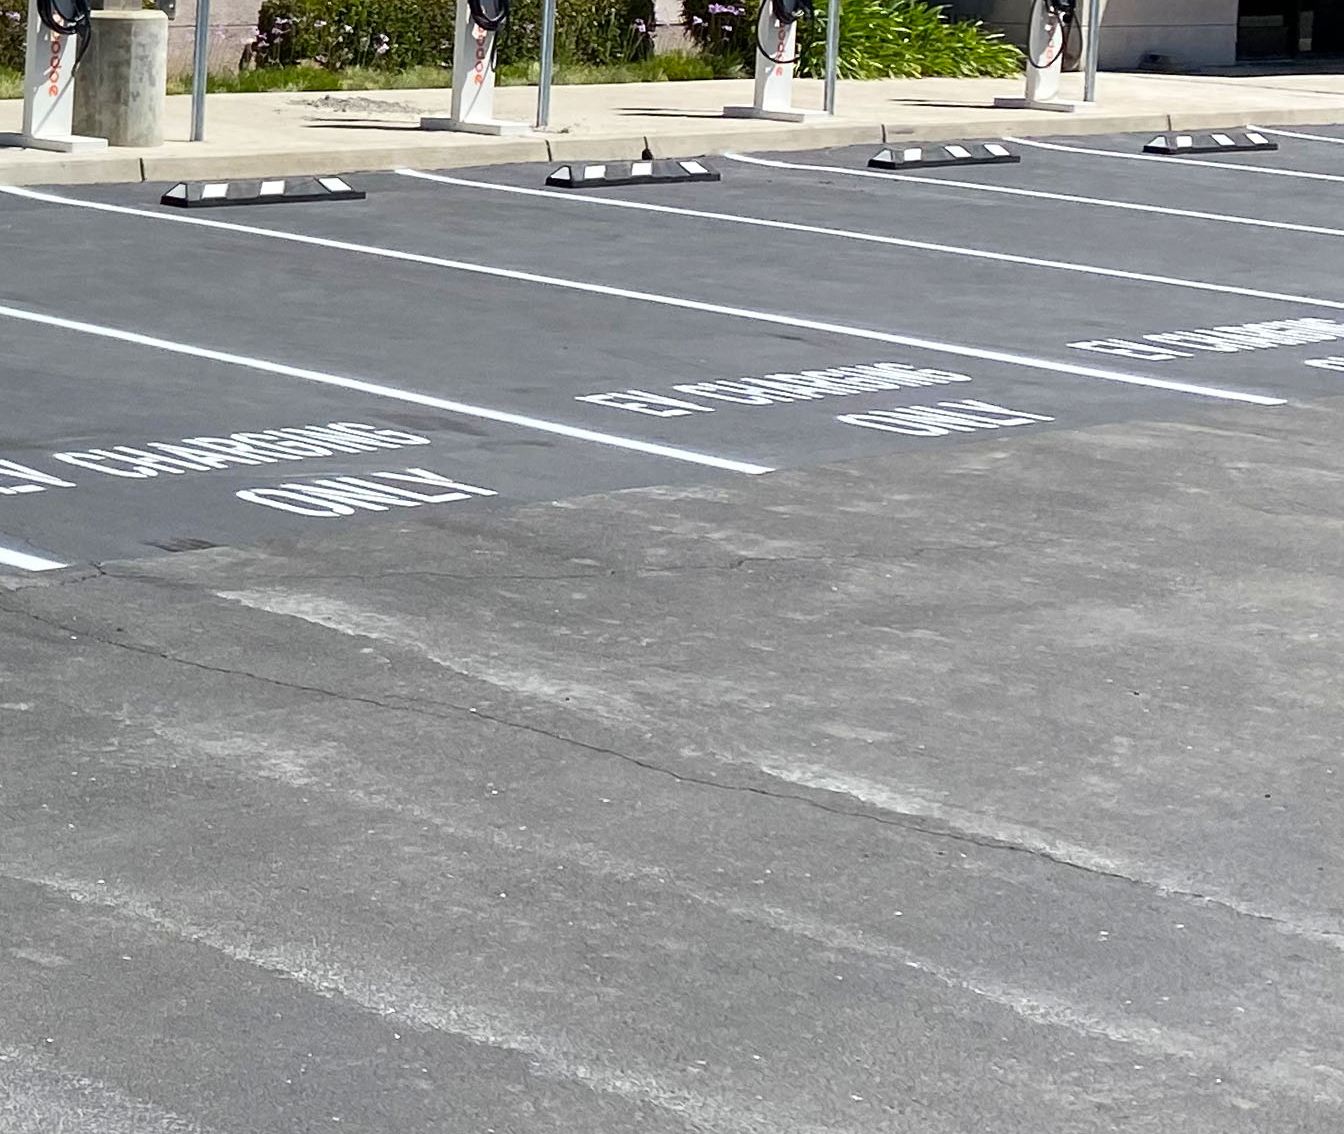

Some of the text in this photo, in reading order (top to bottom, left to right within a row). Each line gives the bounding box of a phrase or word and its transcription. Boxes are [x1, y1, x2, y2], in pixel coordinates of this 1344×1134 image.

[1065, 338, 1195, 361] EV
[574, 361, 973, 417] EV CHARGING
[835, 399, 1056, 437] ONLY
[52, 422, 431, 478] CHARGING
[234, 467, 499, 517] ONLY
